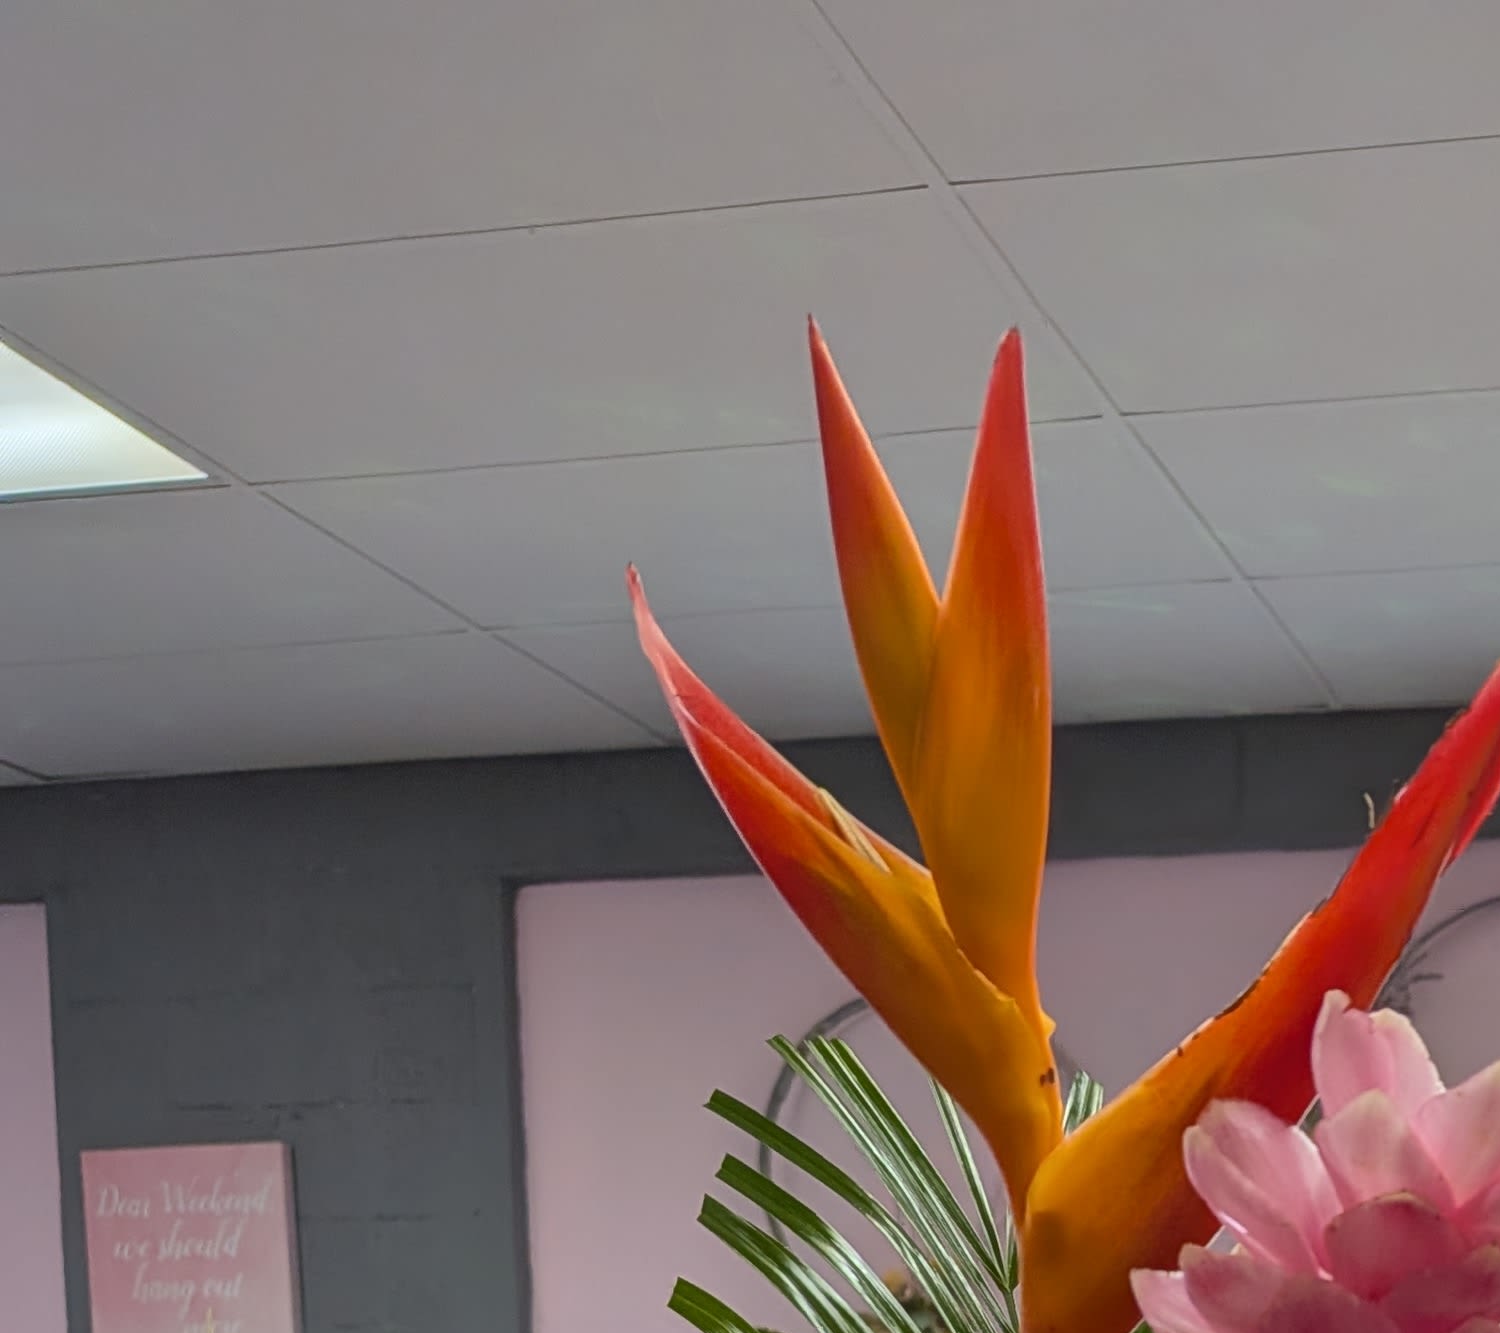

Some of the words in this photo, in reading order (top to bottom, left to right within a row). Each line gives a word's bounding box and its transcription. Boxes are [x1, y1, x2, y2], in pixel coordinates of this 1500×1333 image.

[98, 1184, 150, 1218] Dear
[113, 1239, 149, 1262] we
[157, 1217, 247, 1263] should
[131, 1261, 196, 1321] hang
[202, 1271, 244, 1300] out
